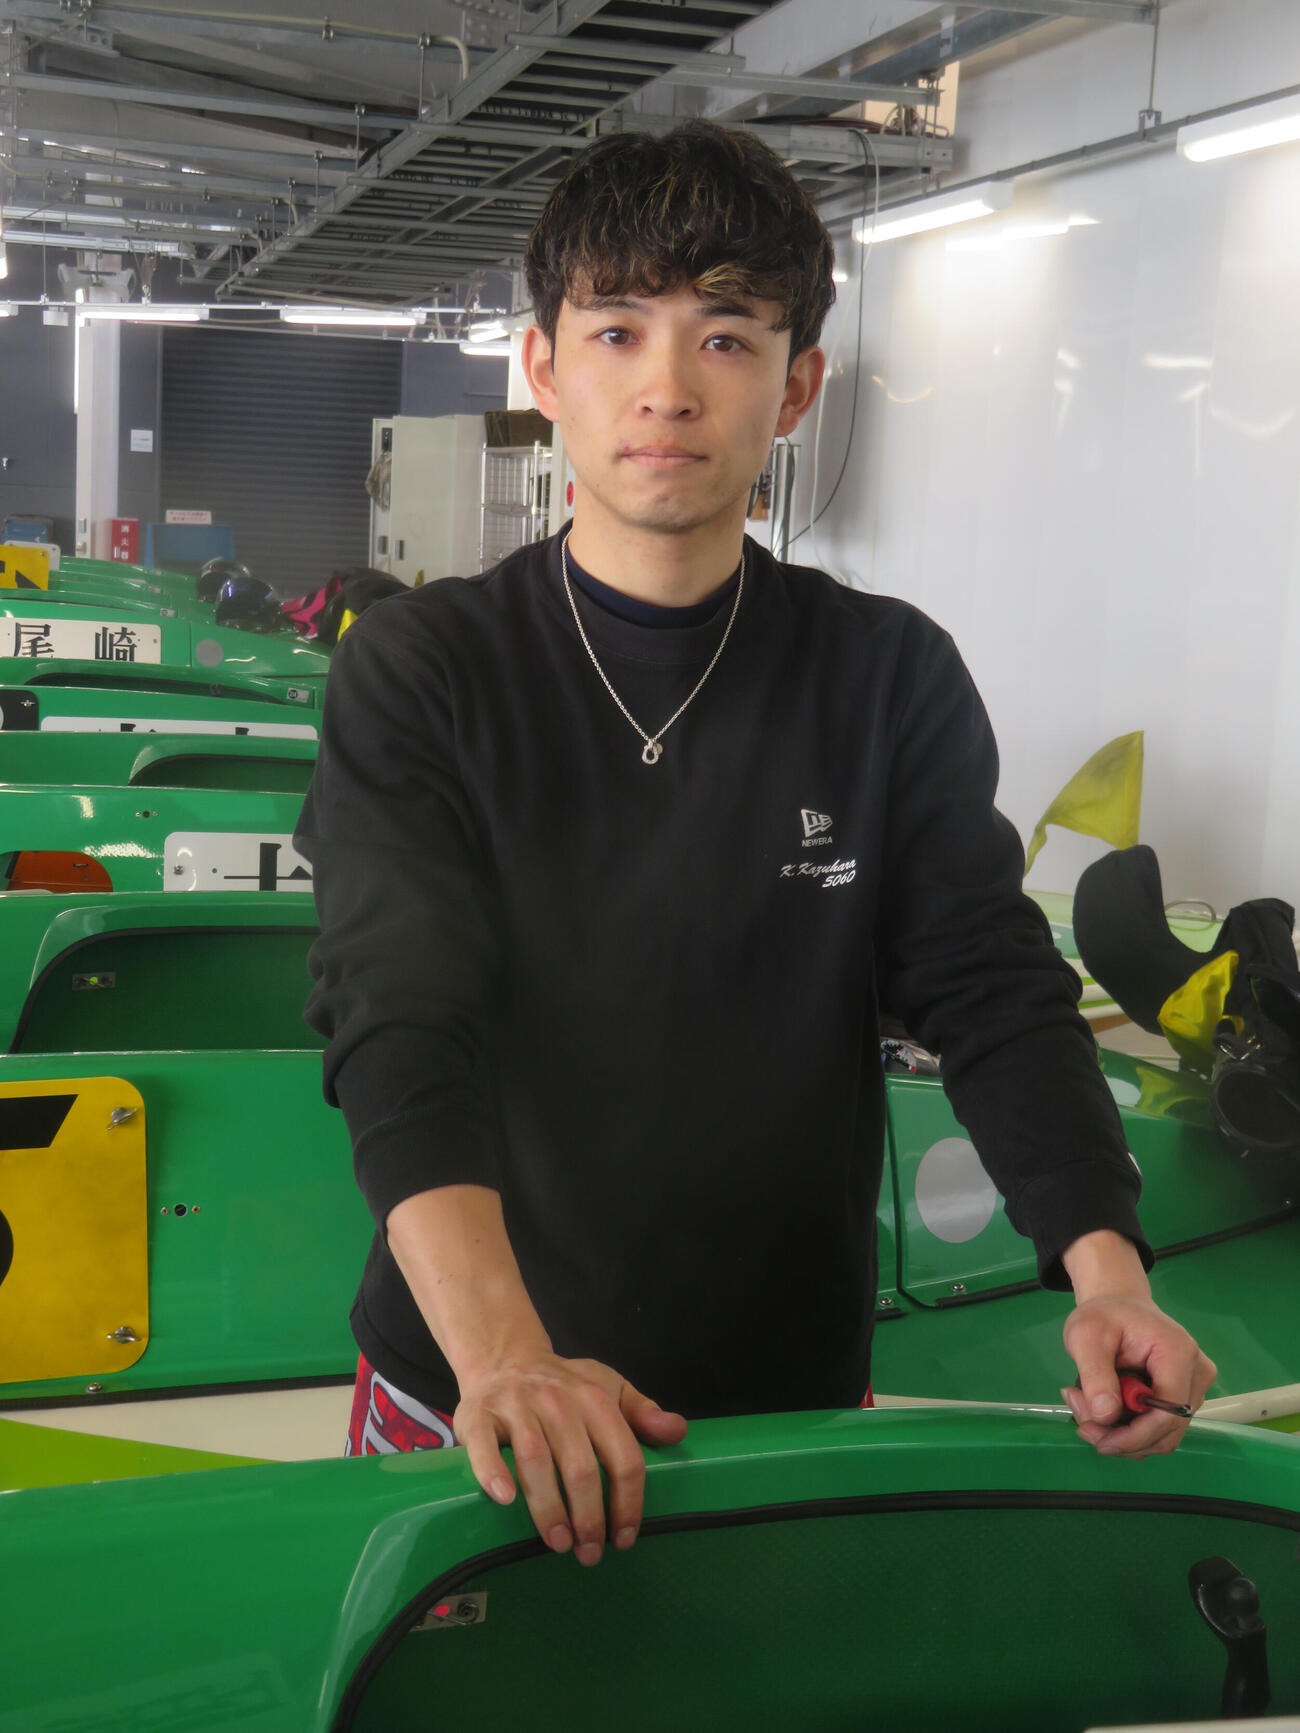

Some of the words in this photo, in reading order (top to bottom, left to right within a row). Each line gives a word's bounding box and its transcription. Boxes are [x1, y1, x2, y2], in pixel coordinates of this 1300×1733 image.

[13, 622, 137, 662] 尾崎
[779, 864, 796, 878] K.
[821, 869, 856, 888] 5060
